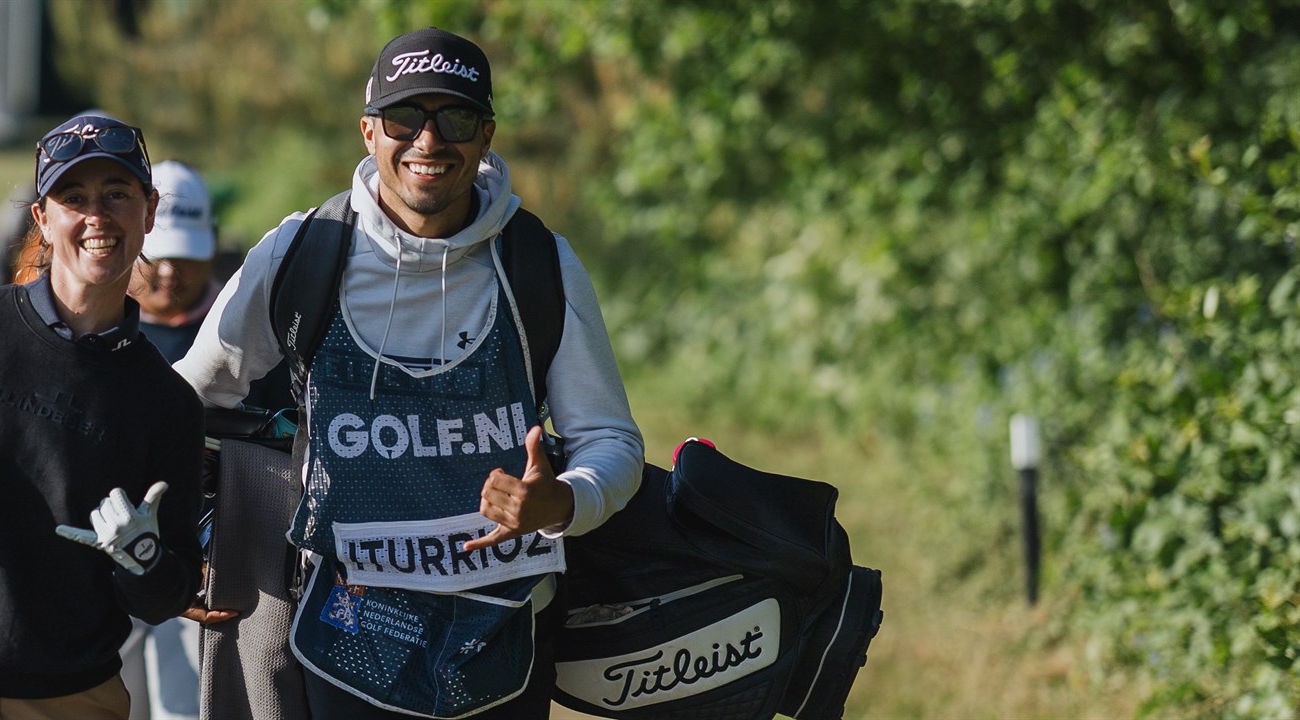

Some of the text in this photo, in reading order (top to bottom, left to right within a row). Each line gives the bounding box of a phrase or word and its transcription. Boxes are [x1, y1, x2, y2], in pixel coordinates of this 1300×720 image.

[385, 49, 480, 82] Titleist
[286, 311, 302, 351] Titleist
[349, 528, 552, 576] ITURRIOZ
[363, 610, 424, 635] NEDERLANDSE
[366, 599, 419, 623] KONINKLIJKE
[360, 620, 428, 649] GOLF FEDERATIE
[602, 628, 763, 706] Titleist
